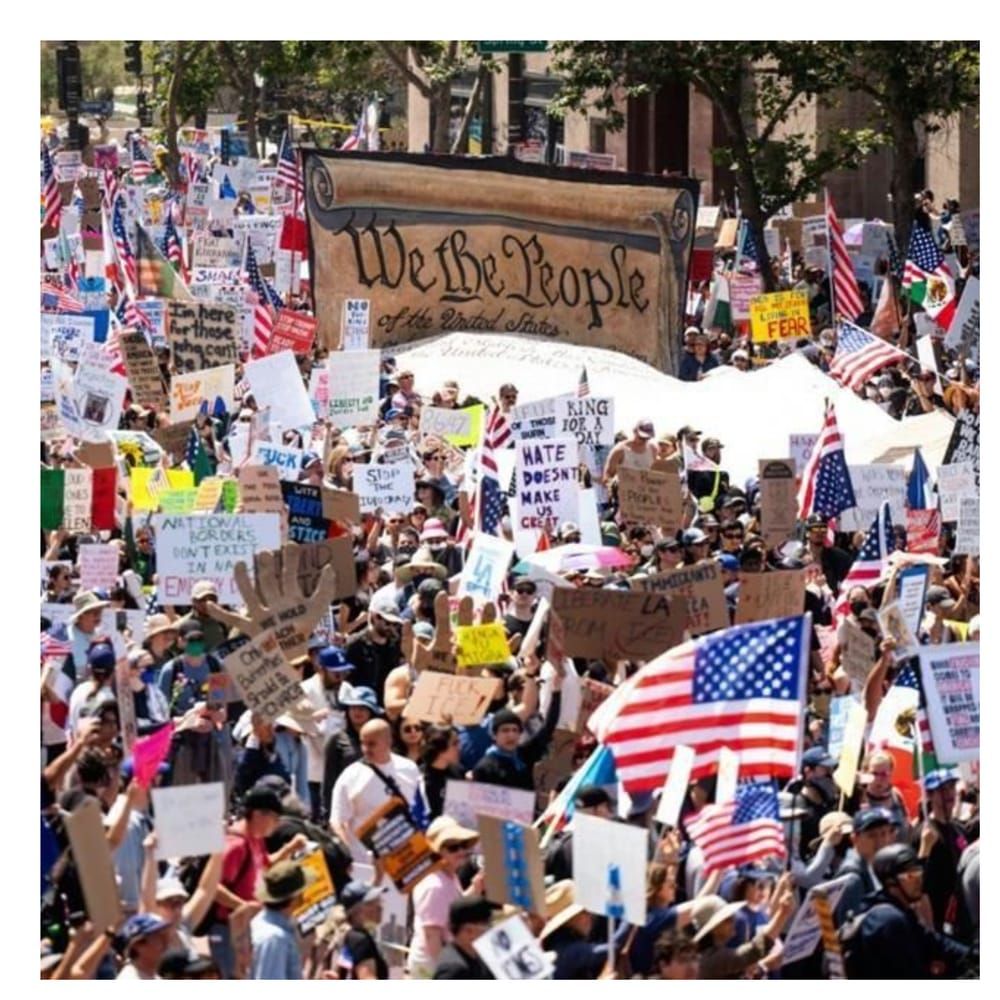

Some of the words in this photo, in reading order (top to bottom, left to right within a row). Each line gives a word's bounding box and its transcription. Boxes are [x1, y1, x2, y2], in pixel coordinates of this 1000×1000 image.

[334, 212, 437, 292] We
[434, 229, 506, 303] the
[502, 234, 650, 331] People
[199, 302, 235, 323] here
[378, 311, 403, 337] of
[402, 310, 434, 330] the
[440, 308, 504, 332] United
[193, 320, 233, 340] those
[768, 317, 808, 338] FEAR
[567, 399, 609, 416] KING
[523, 444, 565, 466] HATE
[520, 488, 561, 507] MAKE
[536, 505, 553, 518] US
[161, 516, 250, 531] NATIONAL
[188, 528, 256, 543] BORDERS
[640, 595, 671, 617] LA
